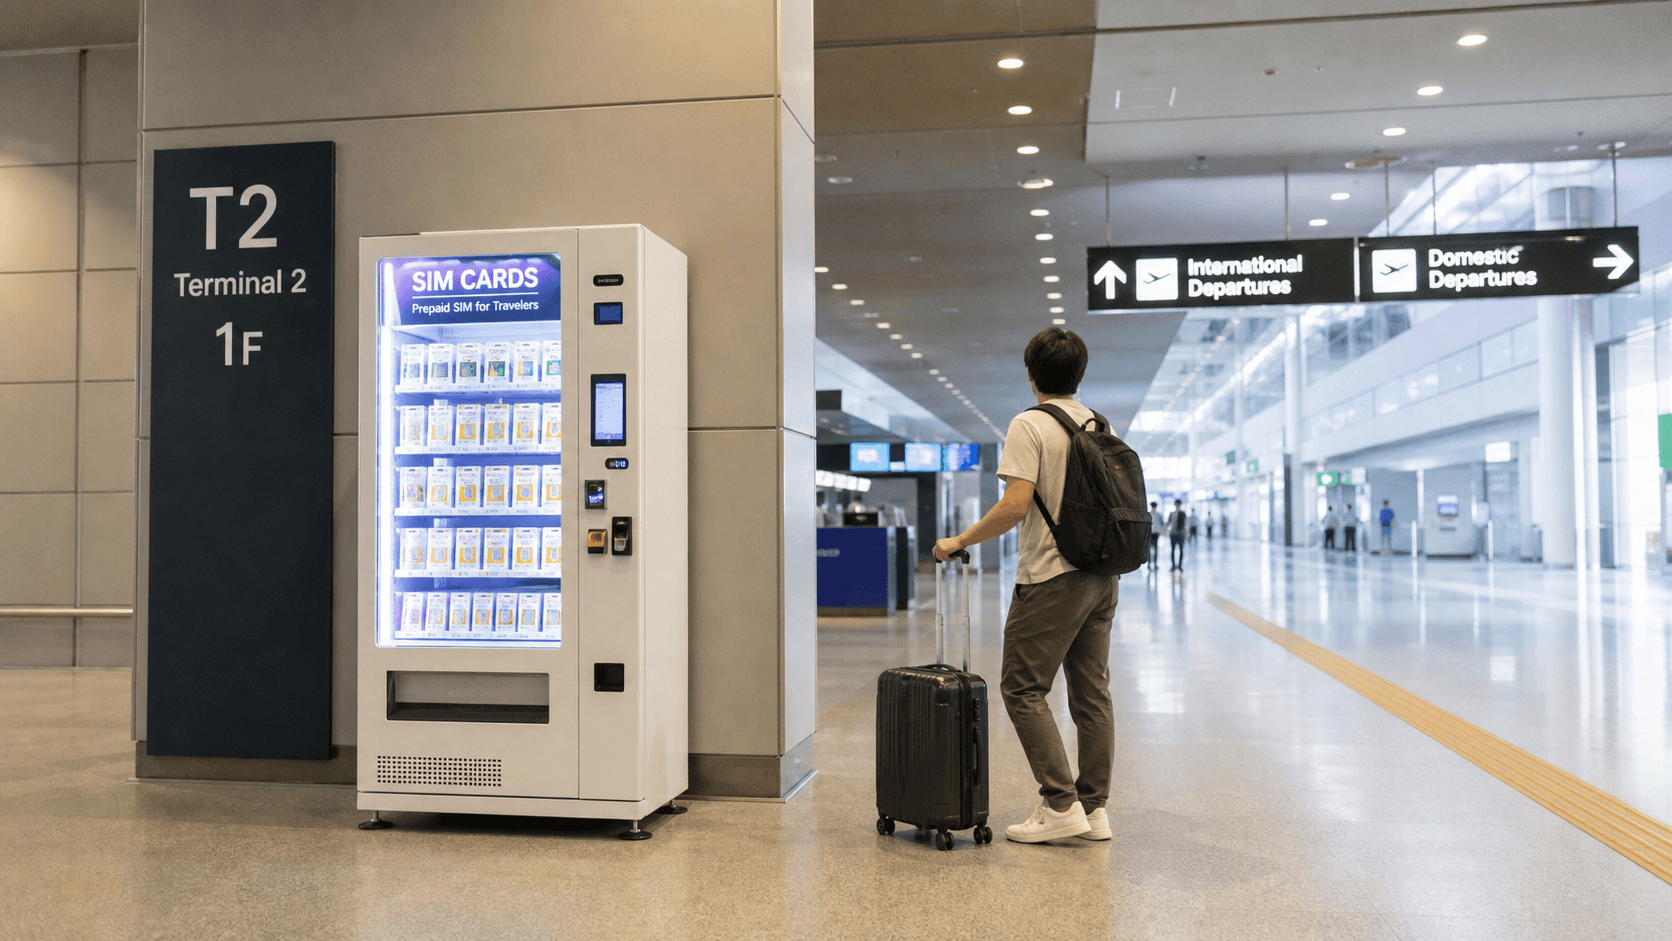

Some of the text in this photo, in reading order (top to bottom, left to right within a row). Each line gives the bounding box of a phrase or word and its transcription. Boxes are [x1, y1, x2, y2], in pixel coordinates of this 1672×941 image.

[189, 184, 278, 251] T2
[1187, 254, 1304, 276] International
[1428, 247, 1520, 268] Domestic
[174, 268, 307, 297] Terminal 2
[412, 267, 539, 292] SIM CARDS
[1188, 278, 1292, 300] Departures
[1429, 269, 1538, 292] Departures
[412, 299, 539, 316] Prepaid SIM for Travelers
